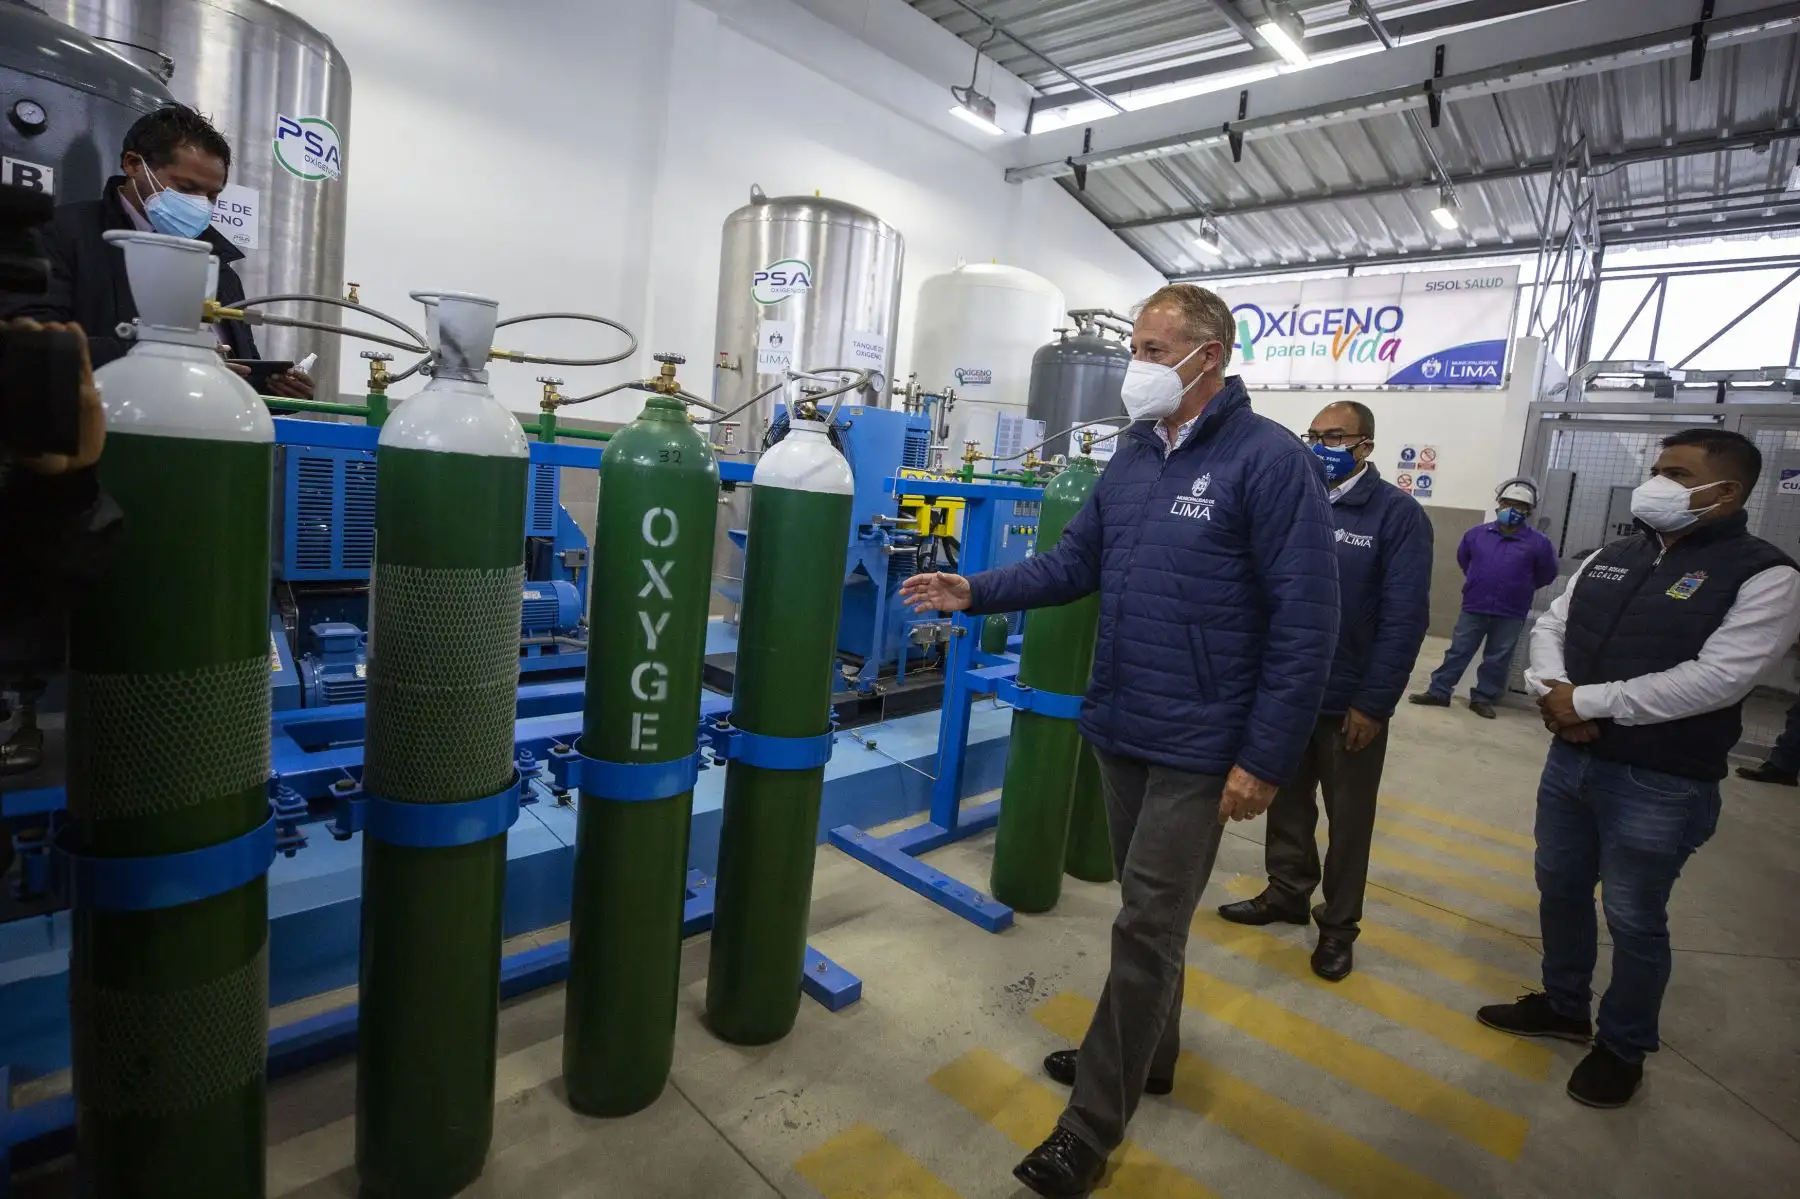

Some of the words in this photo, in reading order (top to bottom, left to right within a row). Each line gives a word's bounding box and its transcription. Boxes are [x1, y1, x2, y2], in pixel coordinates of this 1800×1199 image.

[278, 116, 340, 171] PSA
[12, 162, 44, 193] B
[231, 202, 252, 216] DE
[754, 271, 810, 287] PSA
[1425, 280, 1462, 292] SISOL
[1464, 277, 1504, 289] SALUD
[1265, 344, 1306, 361] para
[1311, 340, 1328, 356] la
[1332, 324, 1402, 363] Vida
[759, 354, 791, 366] LIMA
[1450, 365, 1498, 378] LIMA
[1170, 502, 1211, 521] LIMA
[1345, 536, 1371, 549] LIMA
[1588, 570, 1625, 581] ALCALDE
[630, 507, 679, 751] OXYGE
